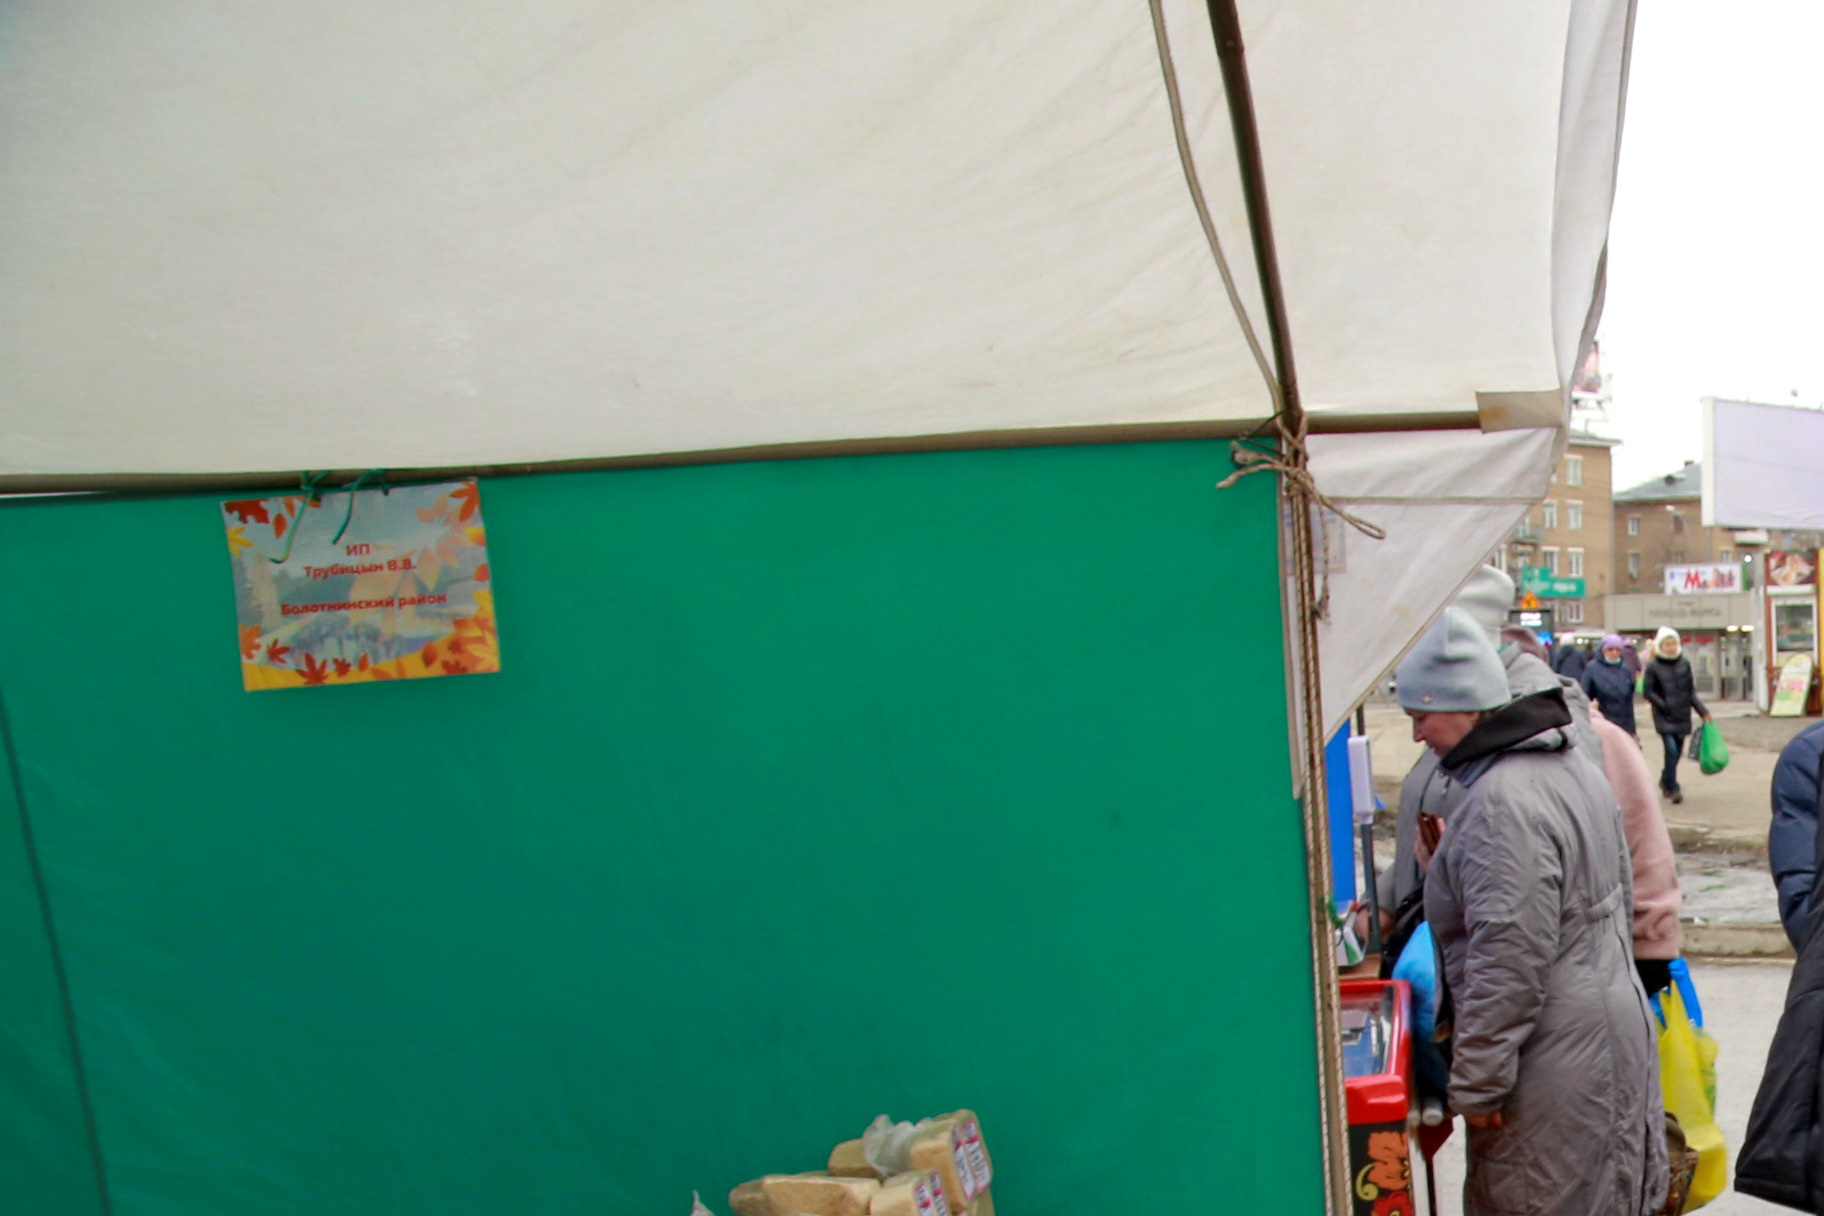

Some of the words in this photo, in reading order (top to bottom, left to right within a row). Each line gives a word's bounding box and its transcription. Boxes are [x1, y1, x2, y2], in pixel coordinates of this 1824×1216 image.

[346, 543, 370, 556] ИП
[304, 560, 384, 580] Трубицын
[281, 594, 394, 616] Болотнинский
[397, 593, 447, 611] район
